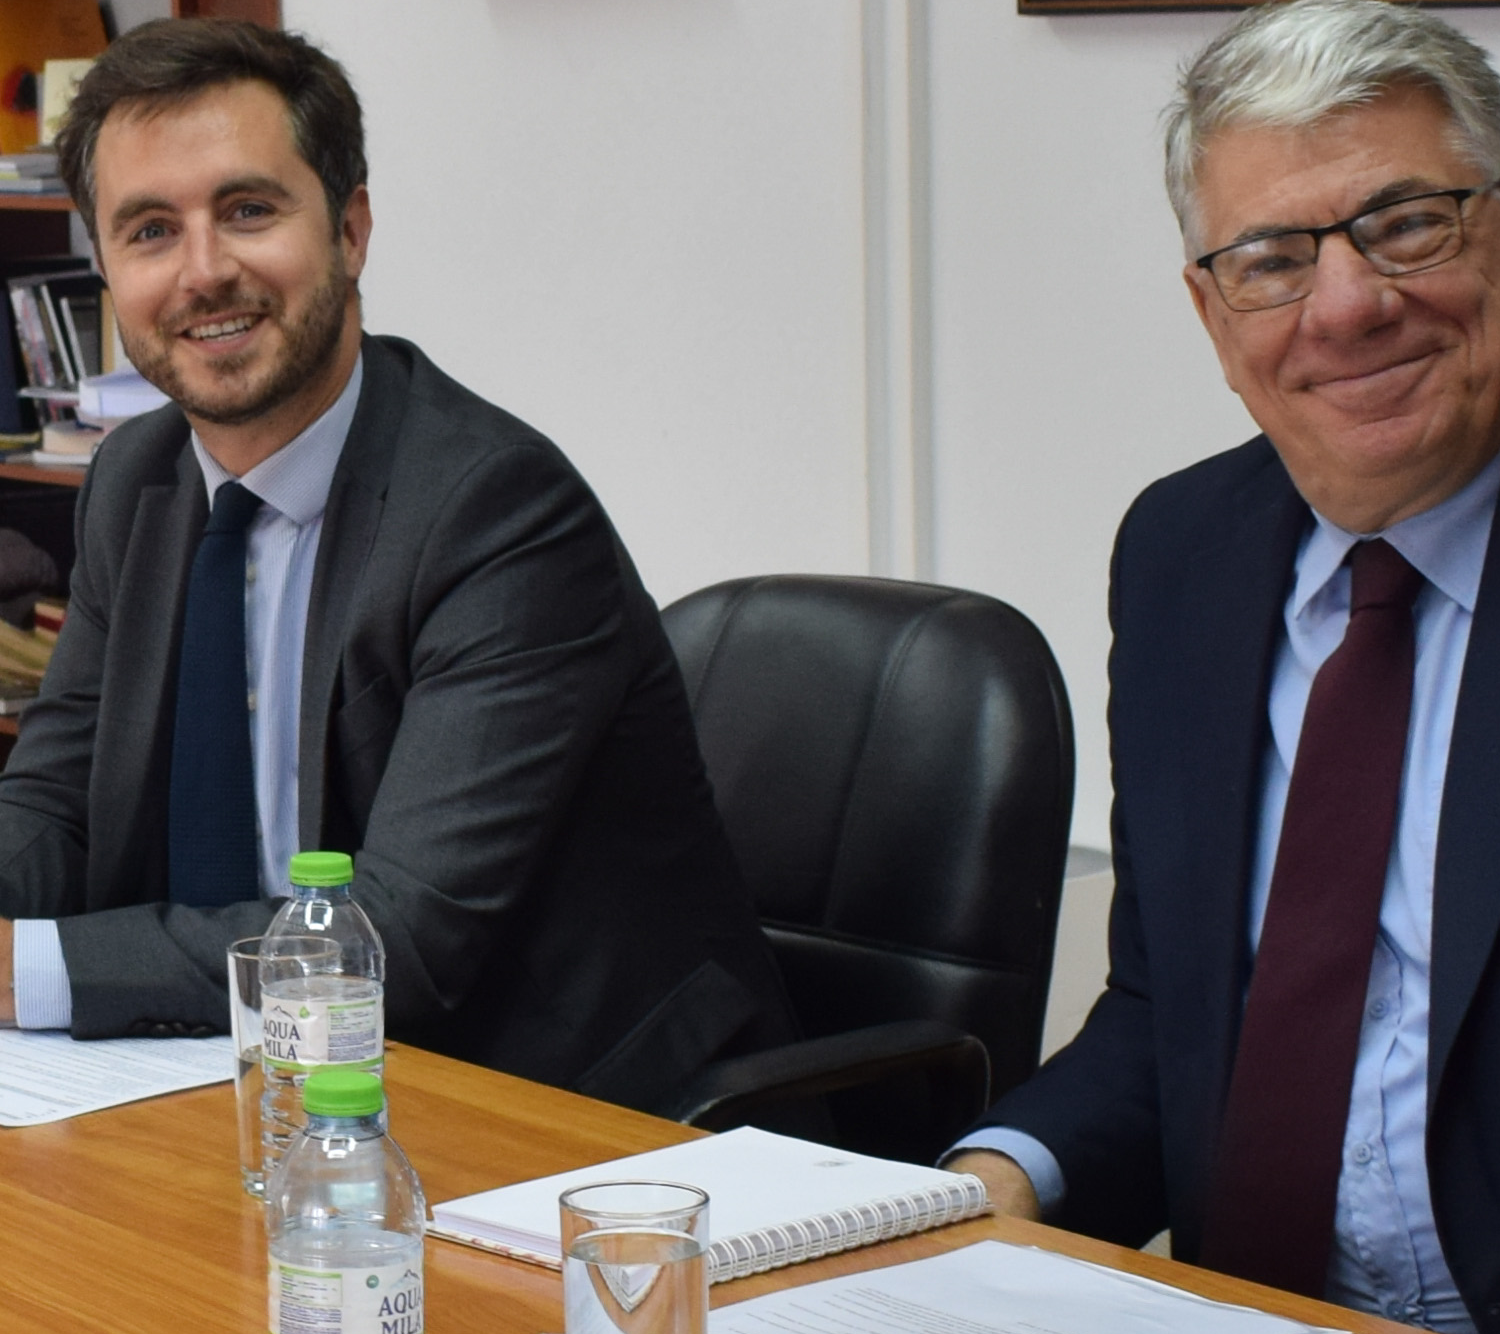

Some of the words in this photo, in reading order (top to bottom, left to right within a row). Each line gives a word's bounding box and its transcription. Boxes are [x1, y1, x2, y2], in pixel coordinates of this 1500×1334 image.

[263, 1018, 302, 1042] AQUA
[263, 1037, 298, 1061] MILA
[378, 1284, 422, 1317] AQUA
